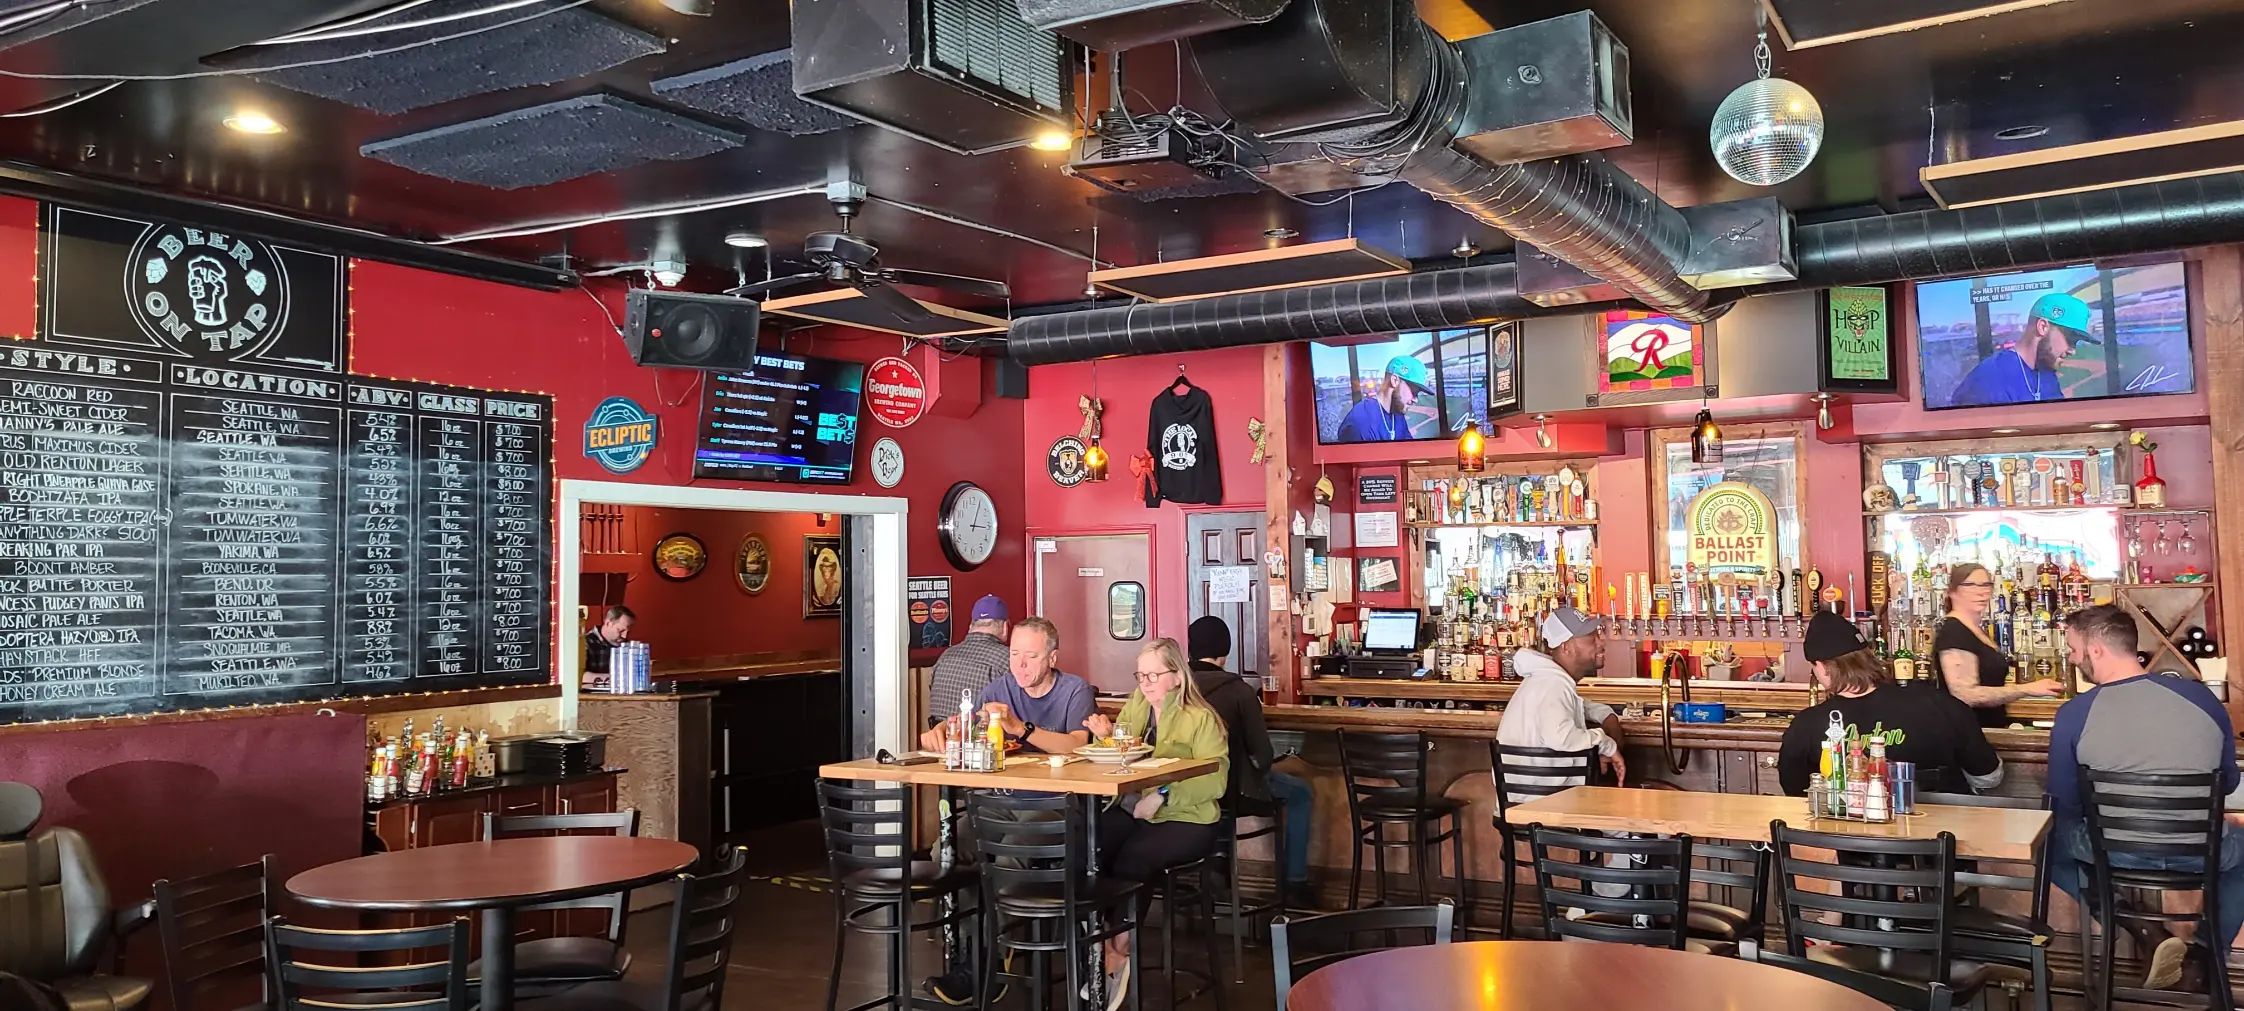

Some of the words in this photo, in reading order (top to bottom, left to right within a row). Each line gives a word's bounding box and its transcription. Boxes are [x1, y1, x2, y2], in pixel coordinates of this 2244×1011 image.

[158, 226, 255, 270] BEER
[2001, 284, 2025, 292] CHANGED
[145, 291, 193, 342] ON
[201, 303, 268, 351] TAP
[1631, 328, 1668, 372] R
[1835, 336, 1881, 353] VILLAIN
[761, 356, 782, 368] BEST
[783, 359, 805, 371] BETS
[11, 350, 117, 375] STYLE
[186, 368, 327, 398] LOCATION
[356, 388, 404, 405] ABV
[420, 394, 477, 412] GLASS
[487, 402, 537, 418] PRICE
[12, 382, 77, 402] RACCOON
[86, 389, 113, 402] RED
[868, 378, 922, 398] Georgetown
[88, 407, 129, 421] CIDER
[0, 417, 55, 431] ANNY'S
[63, 421, 94, 434] PALE
[99, 423, 124, 436] ALE
[261, 435, 277, 447] WA
[590, 423, 652, 448] ECLIPTIC
[0, 435, 25, 449] RUS
[35, 436, 93, 453] MAXIMUS
[99, 442, 140, 456] CIDER
[1051, 439, 1085, 458] BELCHING
[4, 452, 36, 469] OLD
[41, 455, 98, 472] RENTON
[102, 459, 145, 472] LAGER
[43, 475, 96, 489] PINEAPPLE
[98, 477, 129, 491] GUAVA
[1052, 469, 1085, 484] BEAVER
[9, 489, 90, 504] BODHIZAFA
[97, 493, 122, 505] IPA
[29, 507, 82, 522] TERPLE
[88, 509, 124, 523] FOGGY
[1705, 498, 1724, 531] DEDICATED
[1736, 498, 1749, 510] THE
[1747, 509, 1756, 530] CRAFT
[67, 526, 108, 540] DARK?
[119, 527, 157, 541] STOUT
[56, 543, 79, 557] PAR
[85, 544, 104, 557] IPA
[1695, 537, 1764, 549] BALLAST
[264, 546, 279, 558] WA
[1706, 551, 1756, 563] POINT
[15, 561, 65, 576] BOONT
[70, 561, 117, 575] AMBER
[1872, 555, 1884, 573] OFF
[29, 579, 74, 592] BUTTE
[81, 579, 136, 592] PORTER
[256, 578, 275, 591] OR
[908, 581, 932, 591] SEATTLE
[934, 580, 948, 590] BEER
[1871, 578, 1884, 604] FUCK
[43, 597, 86, 611] PUDGEY
[89, 596, 119, 609] PANTS
[126, 595, 144, 609] IPA
[261, 595, 279, 607] WA
[918, 591, 936, 599] SEATTLE
[42, 614, 72, 628] PALE
[77, 614, 103, 626] ALE
[117, 628, 141, 643] IPA
[80, 649, 102, 661] HEF
[34, 667, 91, 681] PREMIUM
[97, 664, 145, 679] BLONDE
[440, 661, 450, 672] 16
[44, 683, 86, 699] CREAM
[94, 682, 117, 696] ALE
